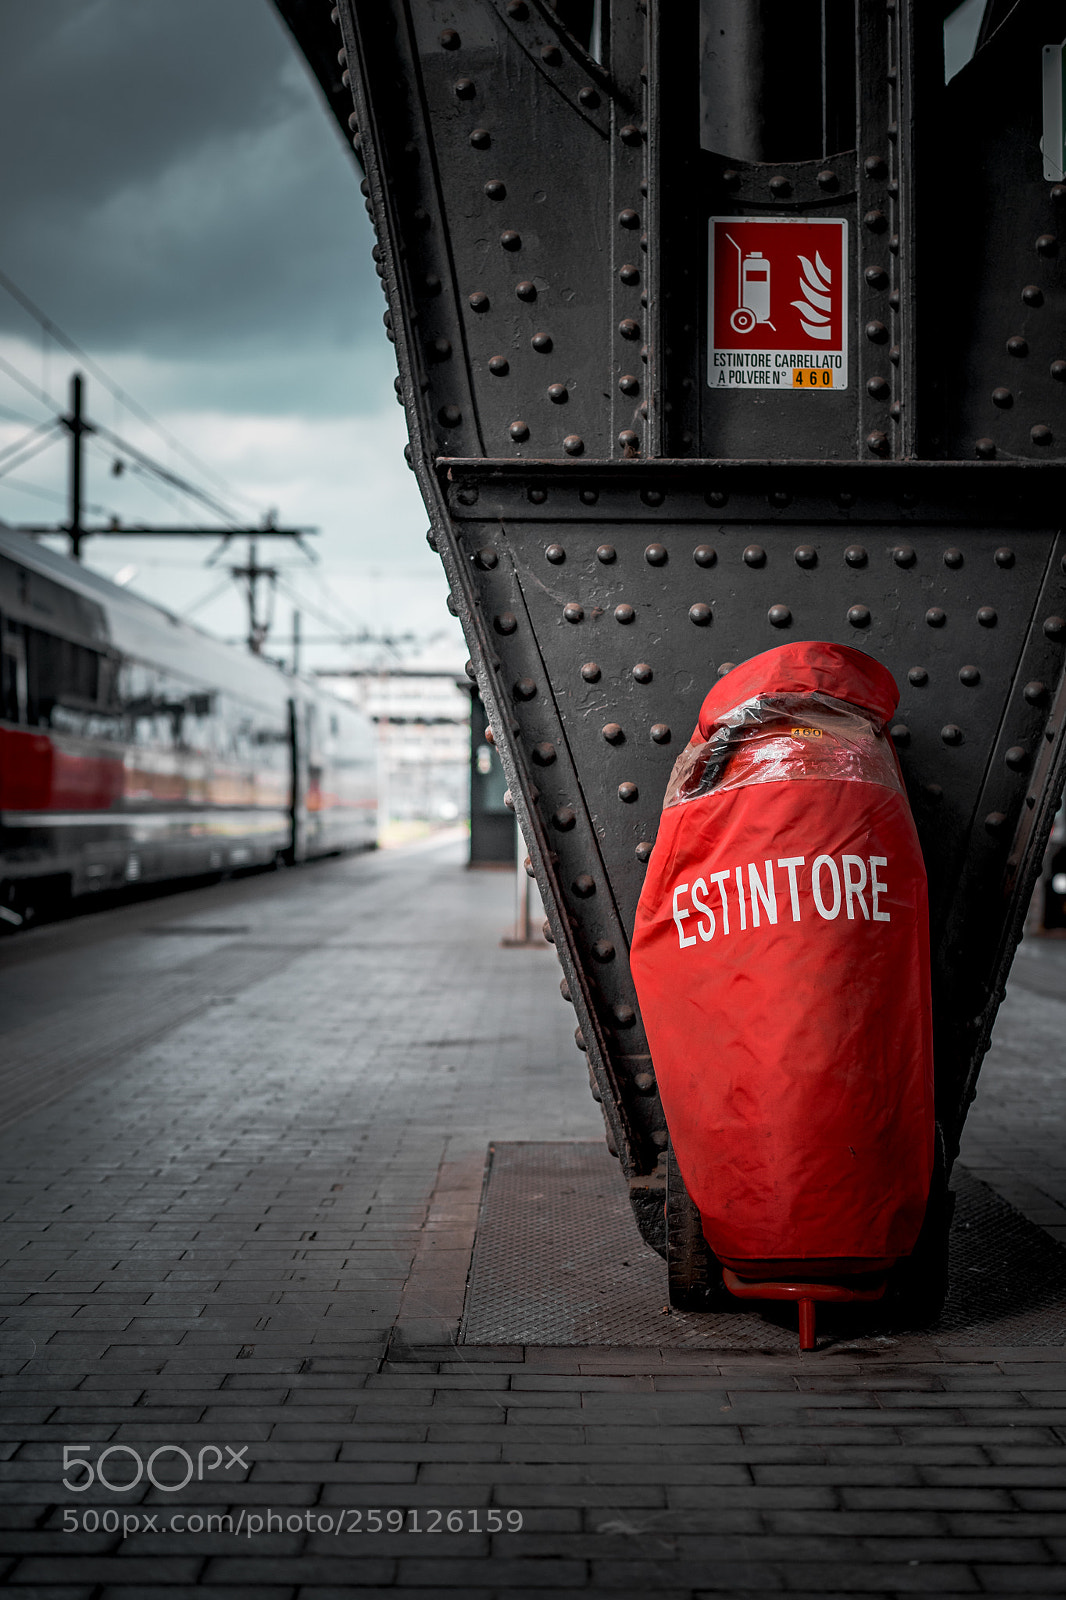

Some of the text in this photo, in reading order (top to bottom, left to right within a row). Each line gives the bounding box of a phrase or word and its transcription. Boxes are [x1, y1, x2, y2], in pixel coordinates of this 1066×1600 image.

[713, 353, 842, 369] ESTINTORE CARRELLATO
[718, 370, 726, 384] A
[728, 371, 770, 385] POLVERE
[793, 728, 821, 737] 460
[672, 854, 891, 949] ESTINTORE
